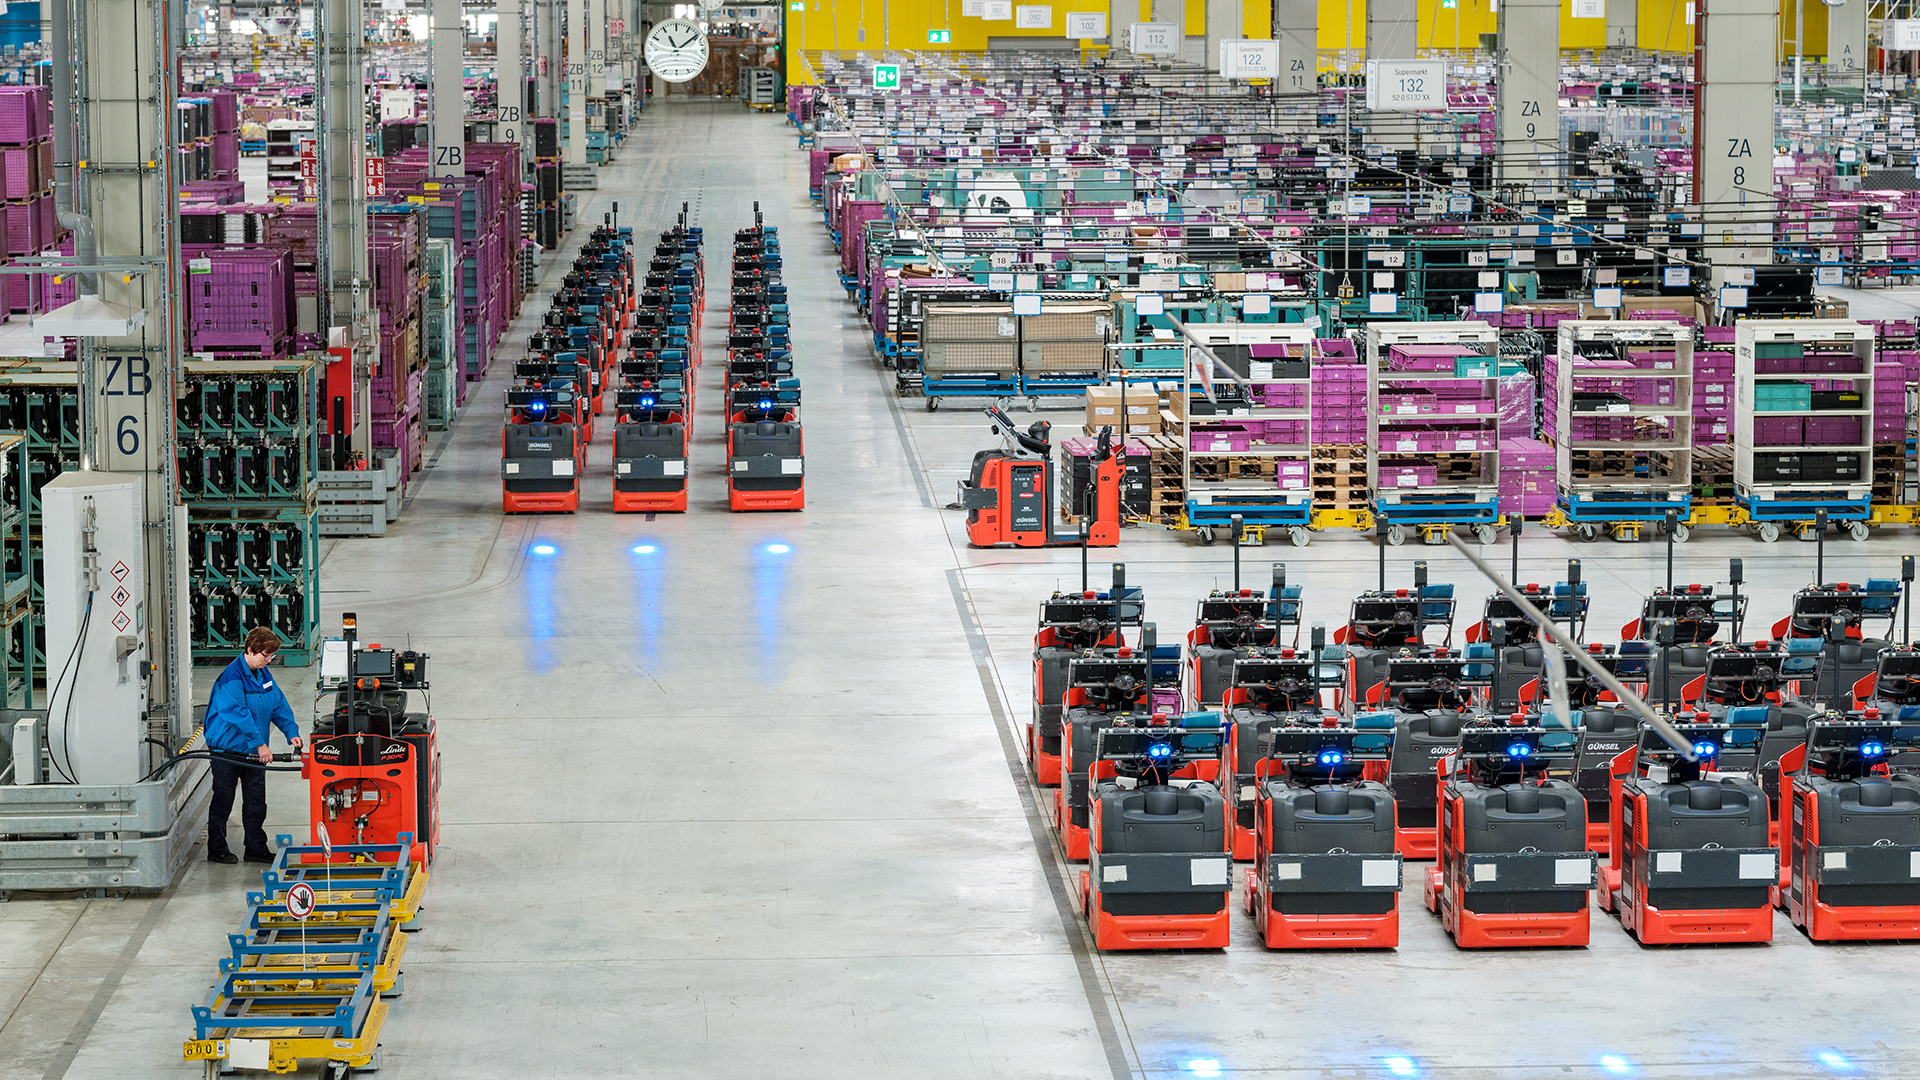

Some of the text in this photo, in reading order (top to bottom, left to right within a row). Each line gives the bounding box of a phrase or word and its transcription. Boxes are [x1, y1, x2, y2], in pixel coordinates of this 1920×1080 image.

[1149, 35, 1164, 44] 112
[591, 50, 603, 60] ZB
[1844, 45, 1851, 54] A
[1242, 54, 1262, 65] 122
[1842, 58, 1853, 68] 12
[569, 64, 584, 75] ZB
[592, 64, 602, 73] 12
[1290, 60, 1305, 71] ZA
[571, 80, 582, 90] 11
[1292, 76, 1303, 86] 11
[1399, 78, 1424, 92] 132
[500, 106, 519, 122] ZB
[1522, 101, 1541, 116] ZA
[506, 128, 514, 143] 9
[1526, 123, 1535, 138] 9
[1728, 139, 1752, 158] ZA
[437, 146, 461, 165] ZB
[1734, 166, 1745, 185] 8
[1278, 255, 1287, 263] 14
[100, 356, 152, 396] ZB
[117, 415, 139, 455] 6
[317, 745, 340, 755] Linde
[380, 744, 406, 754] Linde
